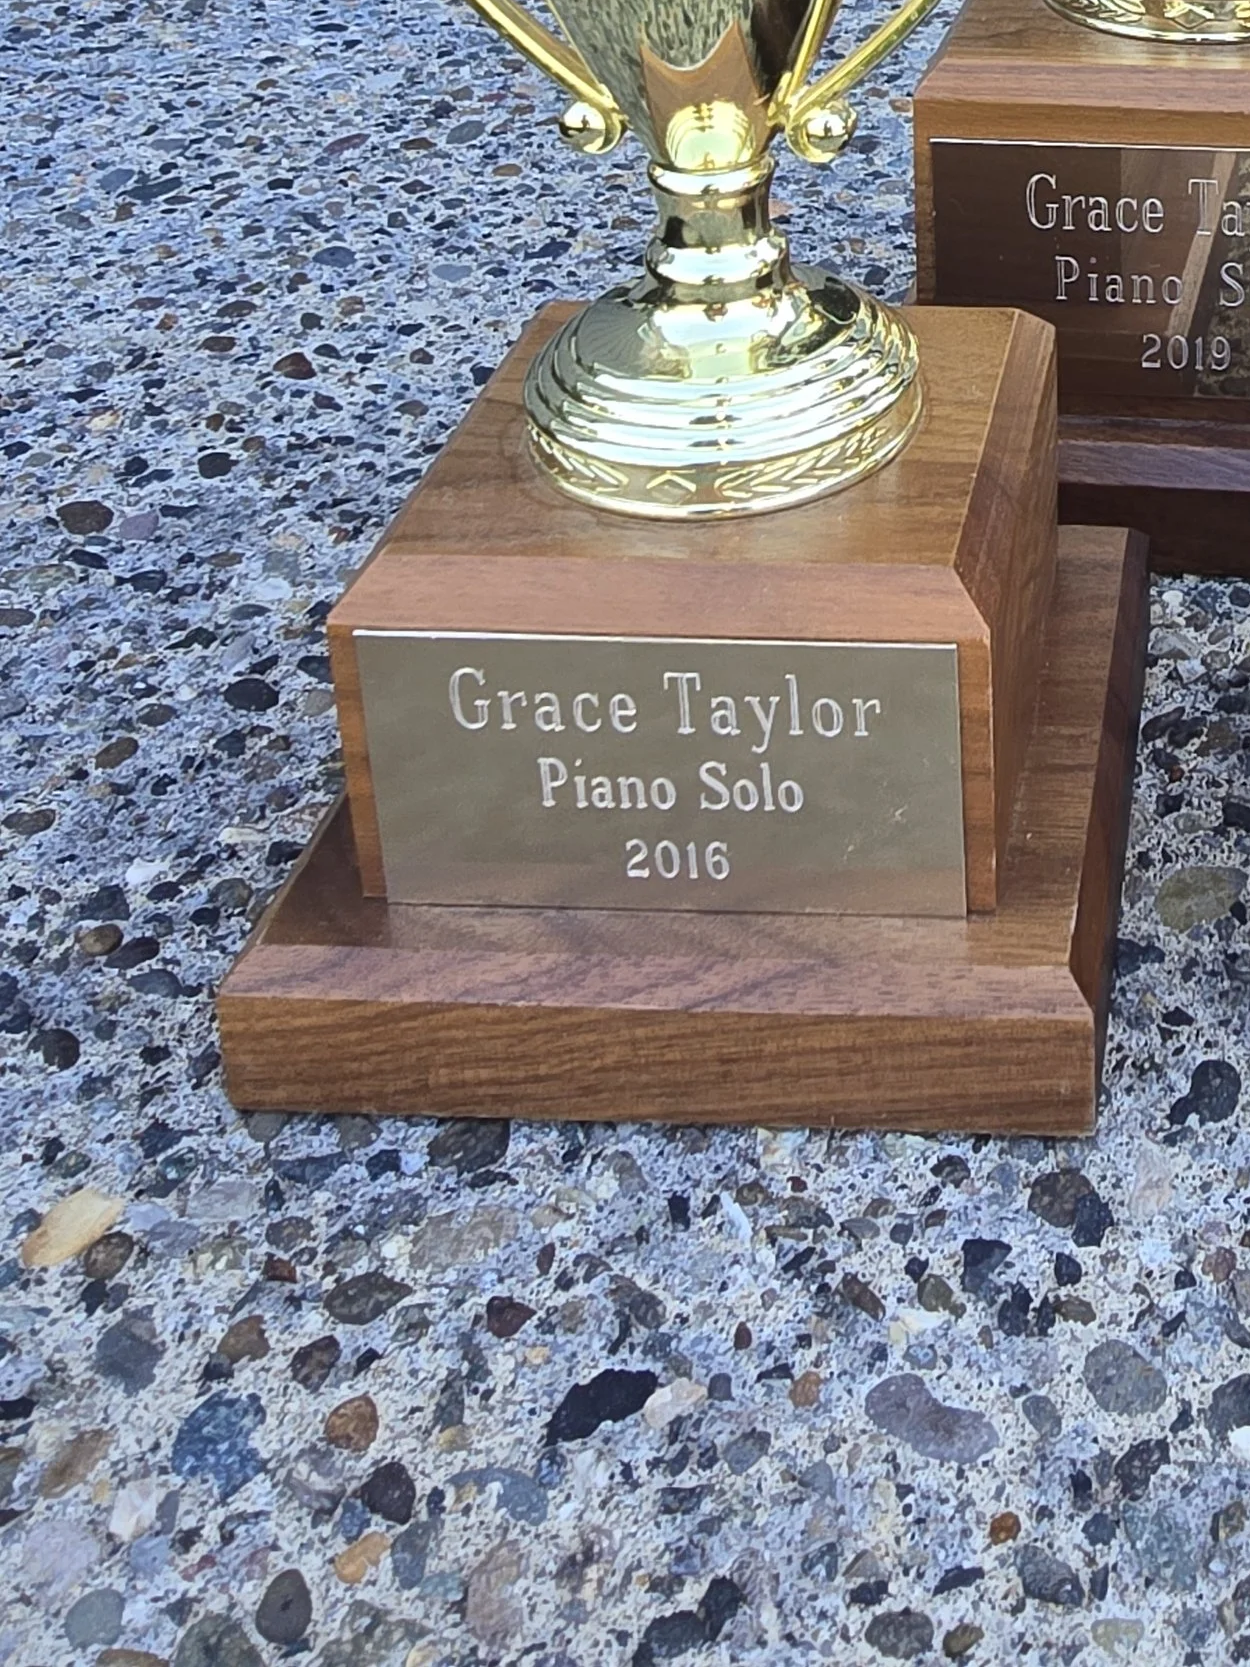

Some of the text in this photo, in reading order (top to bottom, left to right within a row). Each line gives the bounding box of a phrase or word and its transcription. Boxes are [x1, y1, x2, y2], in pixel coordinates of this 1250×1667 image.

[1025, 172, 1165, 234] Grace
[1054, 256, 1183, 306] Piano
[1141, 334, 1232, 371] 2019
[448, 666, 881, 753] Grace Taylor
[537, 756, 804, 813] Piano Solo
[624, 838, 731, 881] 2016
